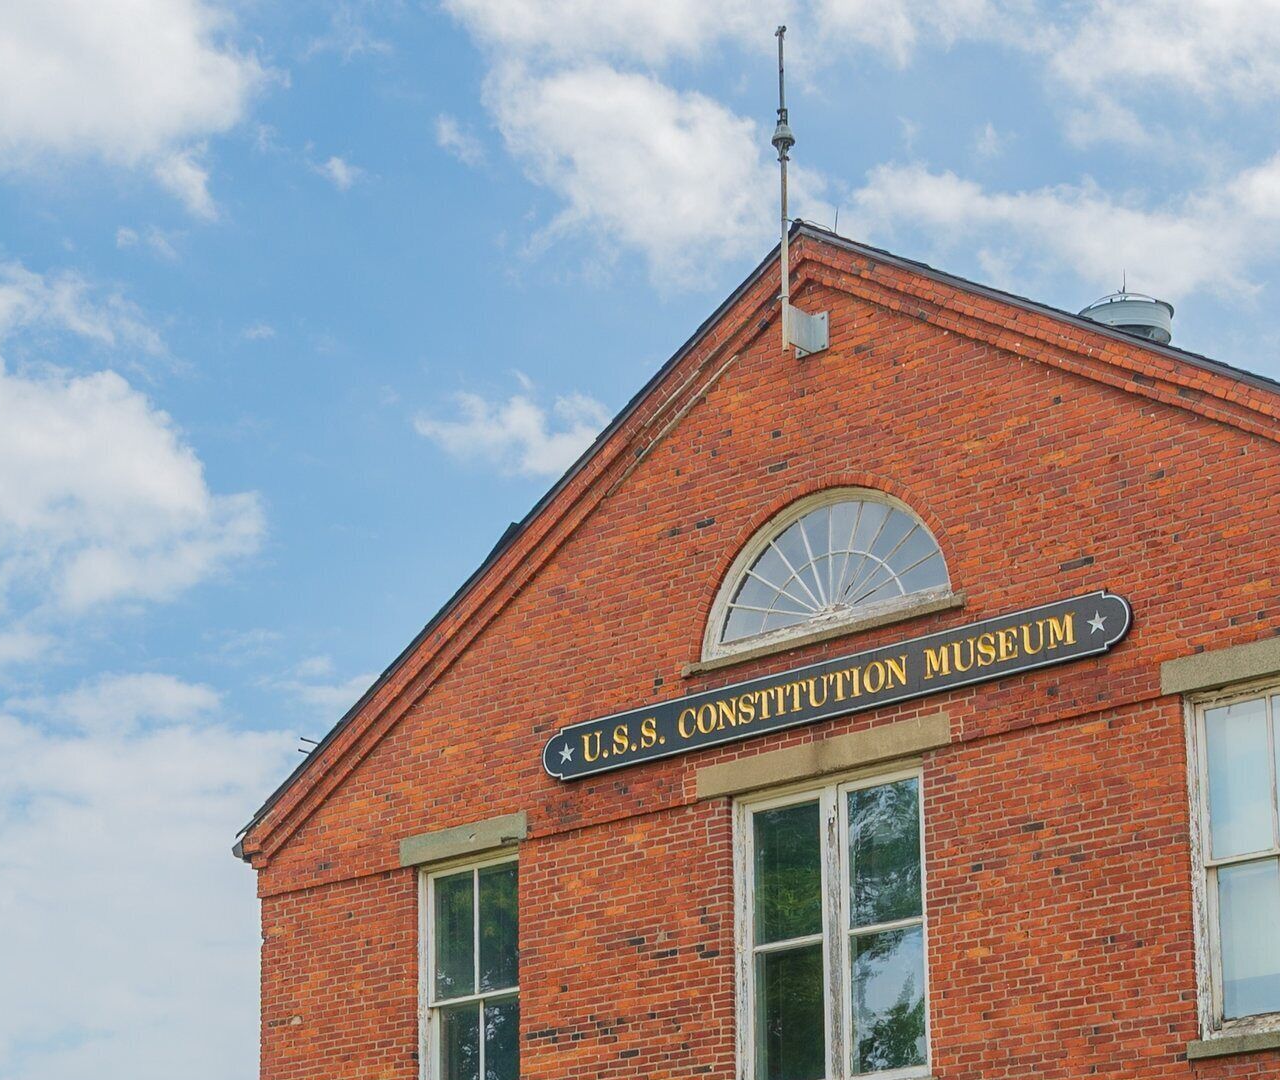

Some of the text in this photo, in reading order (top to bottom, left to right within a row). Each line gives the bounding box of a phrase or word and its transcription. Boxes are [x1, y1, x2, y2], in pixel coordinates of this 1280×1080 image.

[581, 611, 1077, 763] U.S.S. CONSTITUTION MUSEUM
